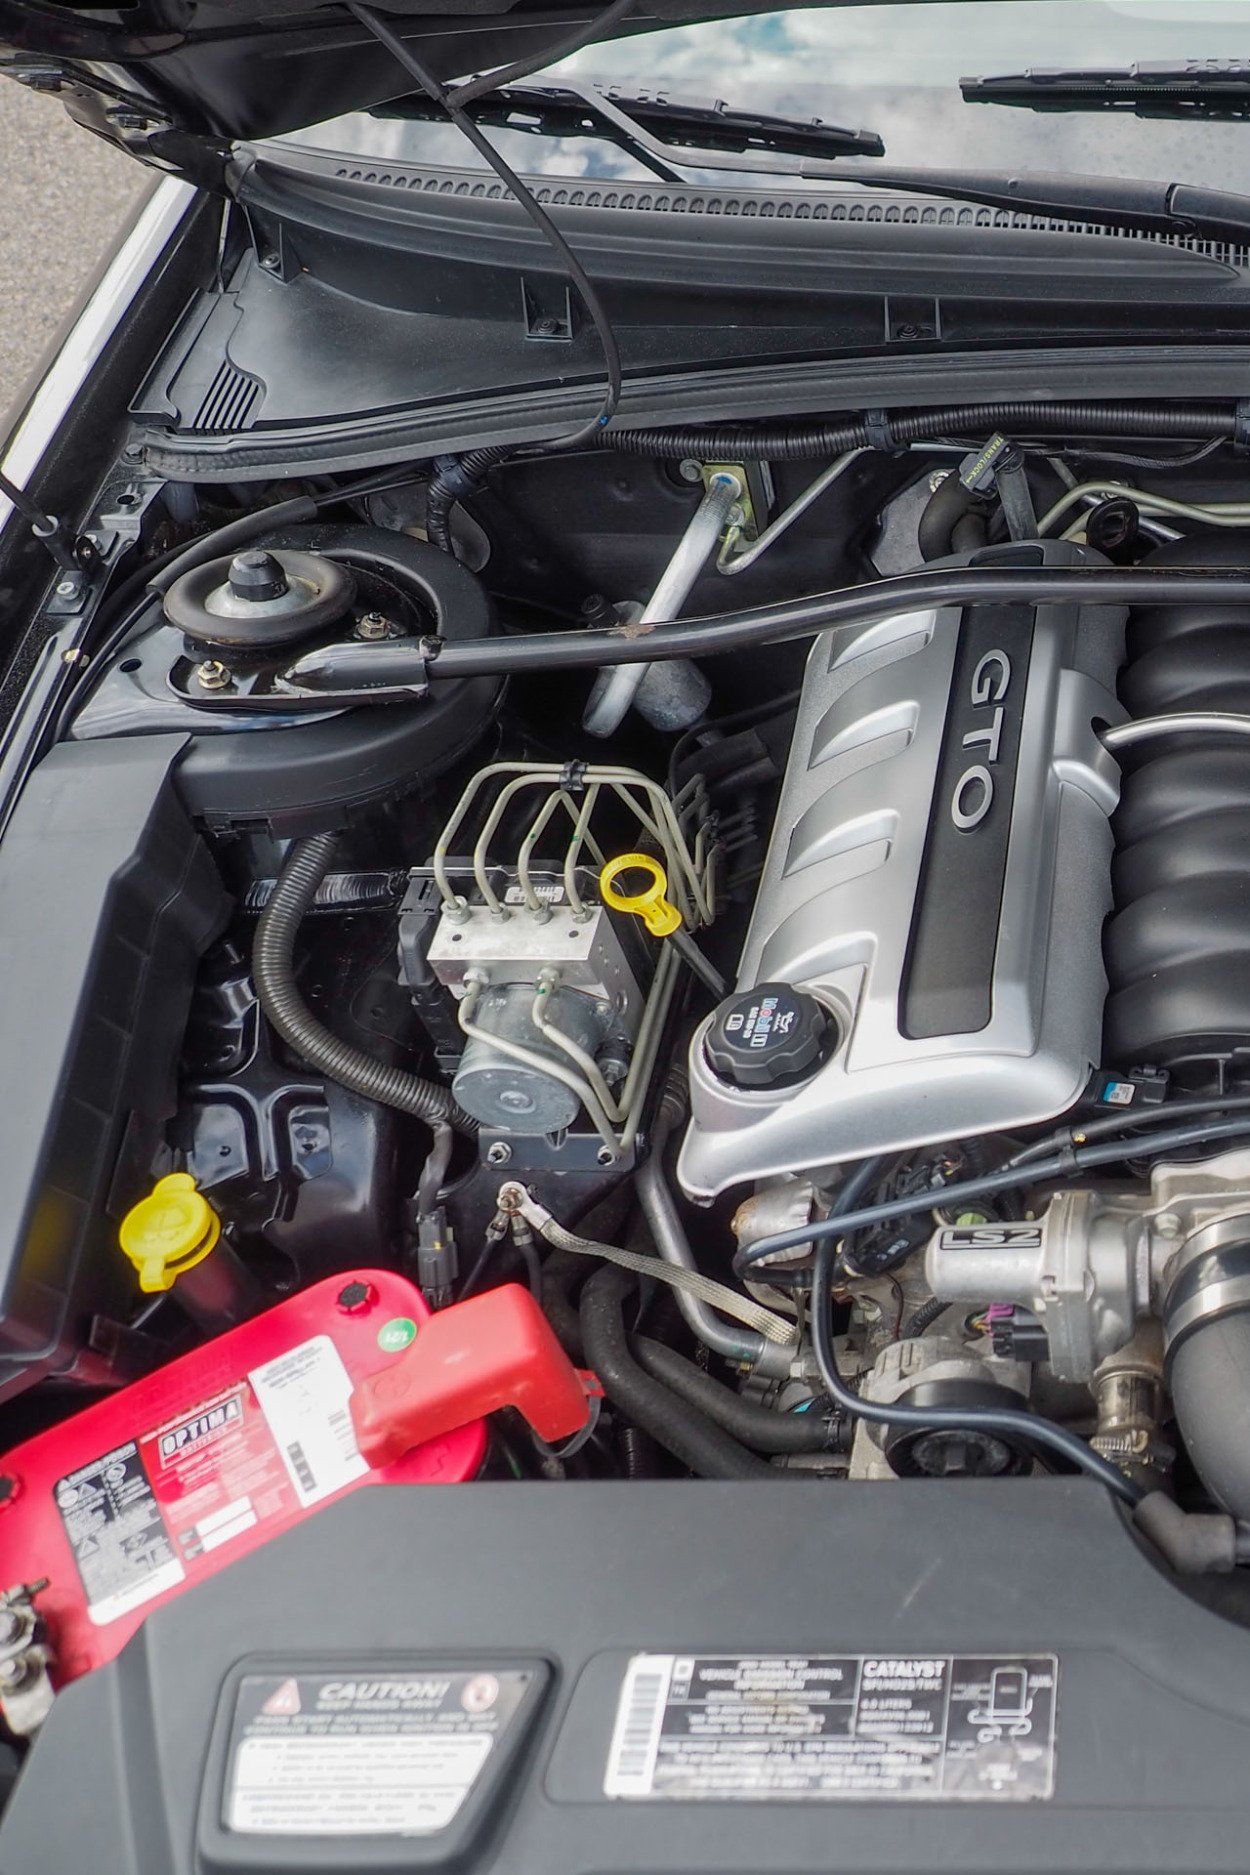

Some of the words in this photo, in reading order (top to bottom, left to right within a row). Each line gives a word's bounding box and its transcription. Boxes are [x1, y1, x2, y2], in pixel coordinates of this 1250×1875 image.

[951, 649, 1011, 829] GTO
[942, 1229, 1041, 1246] LS2
[162, 1399, 240, 1456] OPTIMA
[863, 1660, 945, 1678] CATALYST
[318, 1680, 451, 1701] CAUTION!
